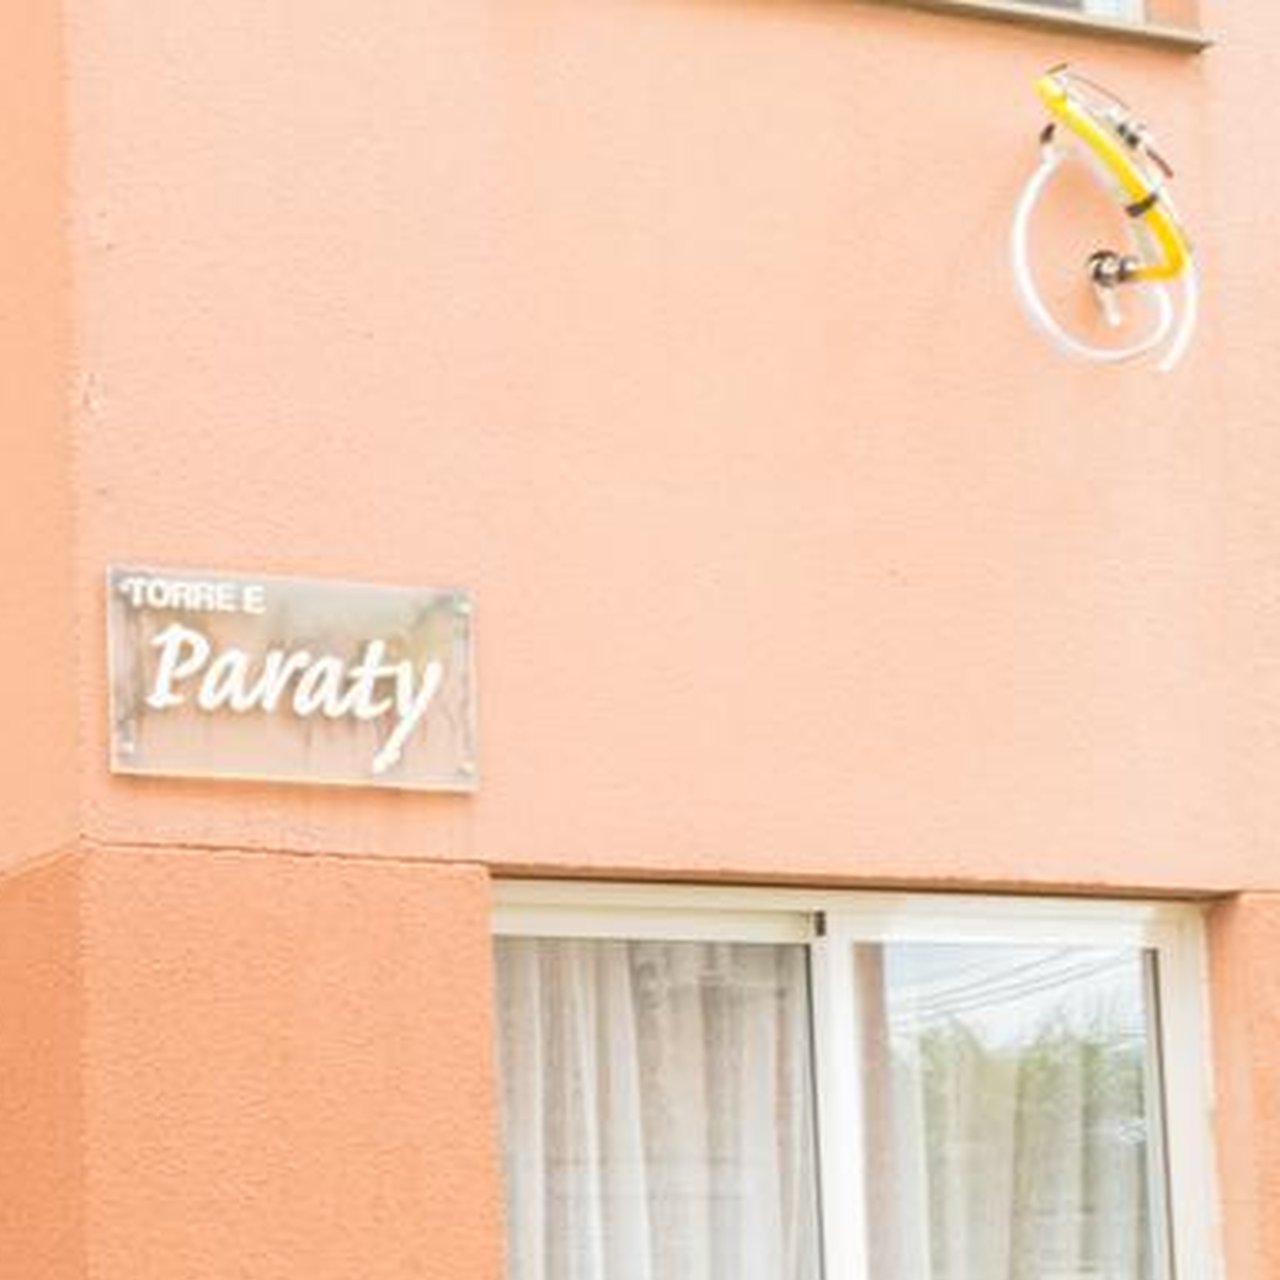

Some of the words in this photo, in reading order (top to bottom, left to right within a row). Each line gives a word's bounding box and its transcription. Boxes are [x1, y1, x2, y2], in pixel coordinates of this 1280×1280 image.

[125, 577, 236, 613] TORRE
[242, 585, 265, 613] E
[146, 623, 442, 773] Paraty
